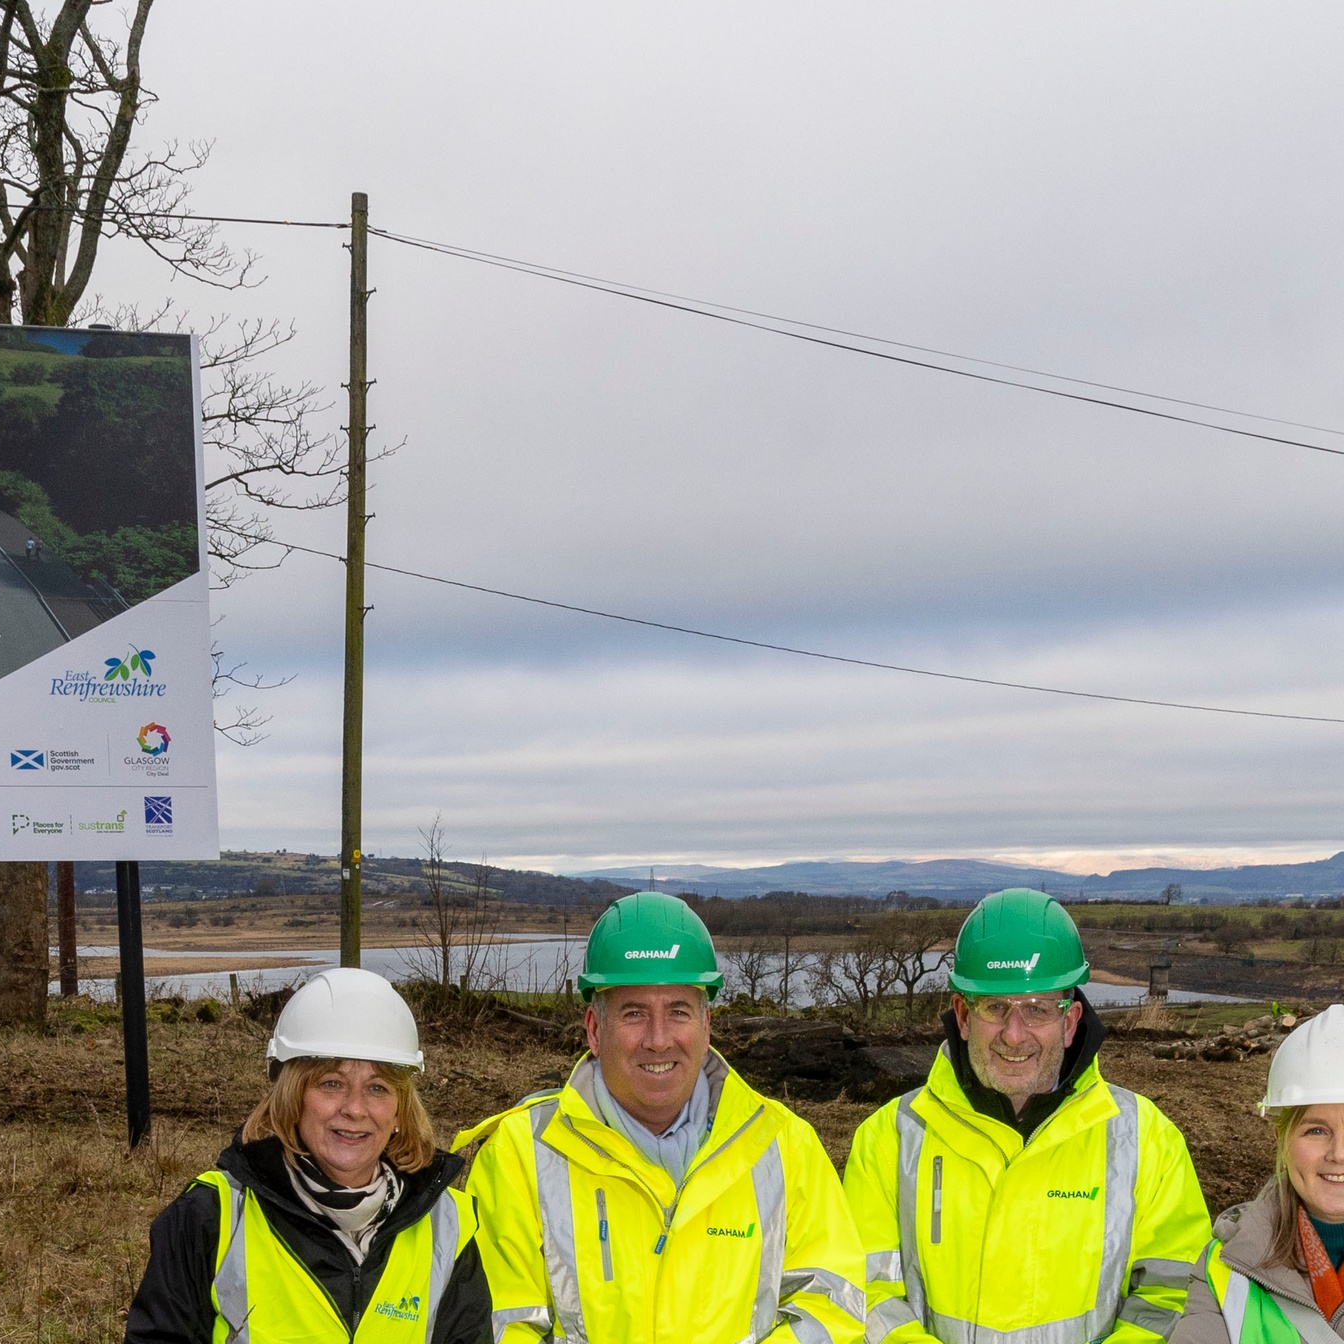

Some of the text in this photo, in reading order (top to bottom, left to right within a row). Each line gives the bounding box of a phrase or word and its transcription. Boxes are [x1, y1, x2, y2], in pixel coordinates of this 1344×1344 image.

[64, 670, 90, 682] East
[49, 676, 167, 702] Renfrewshire
[49, 750, 80, 758] Scottish
[50, 757, 95, 766] Government
[123, 756, 171, 766] GLASGOW
[50, 764, 81, 772] gov.scot
[32, 821, 65, 829] Places for
[77, 820, 125, 831] sustrans
[33, 828, 63, 836] Everyone
[624, 950, 670, 960] GRAHAM
[986, 960, 1031, 970] GRAHAM
[1047, 1190, 1090, 1199] GRAHAM
[706, 1227, 746, 1239] GRAHAM
